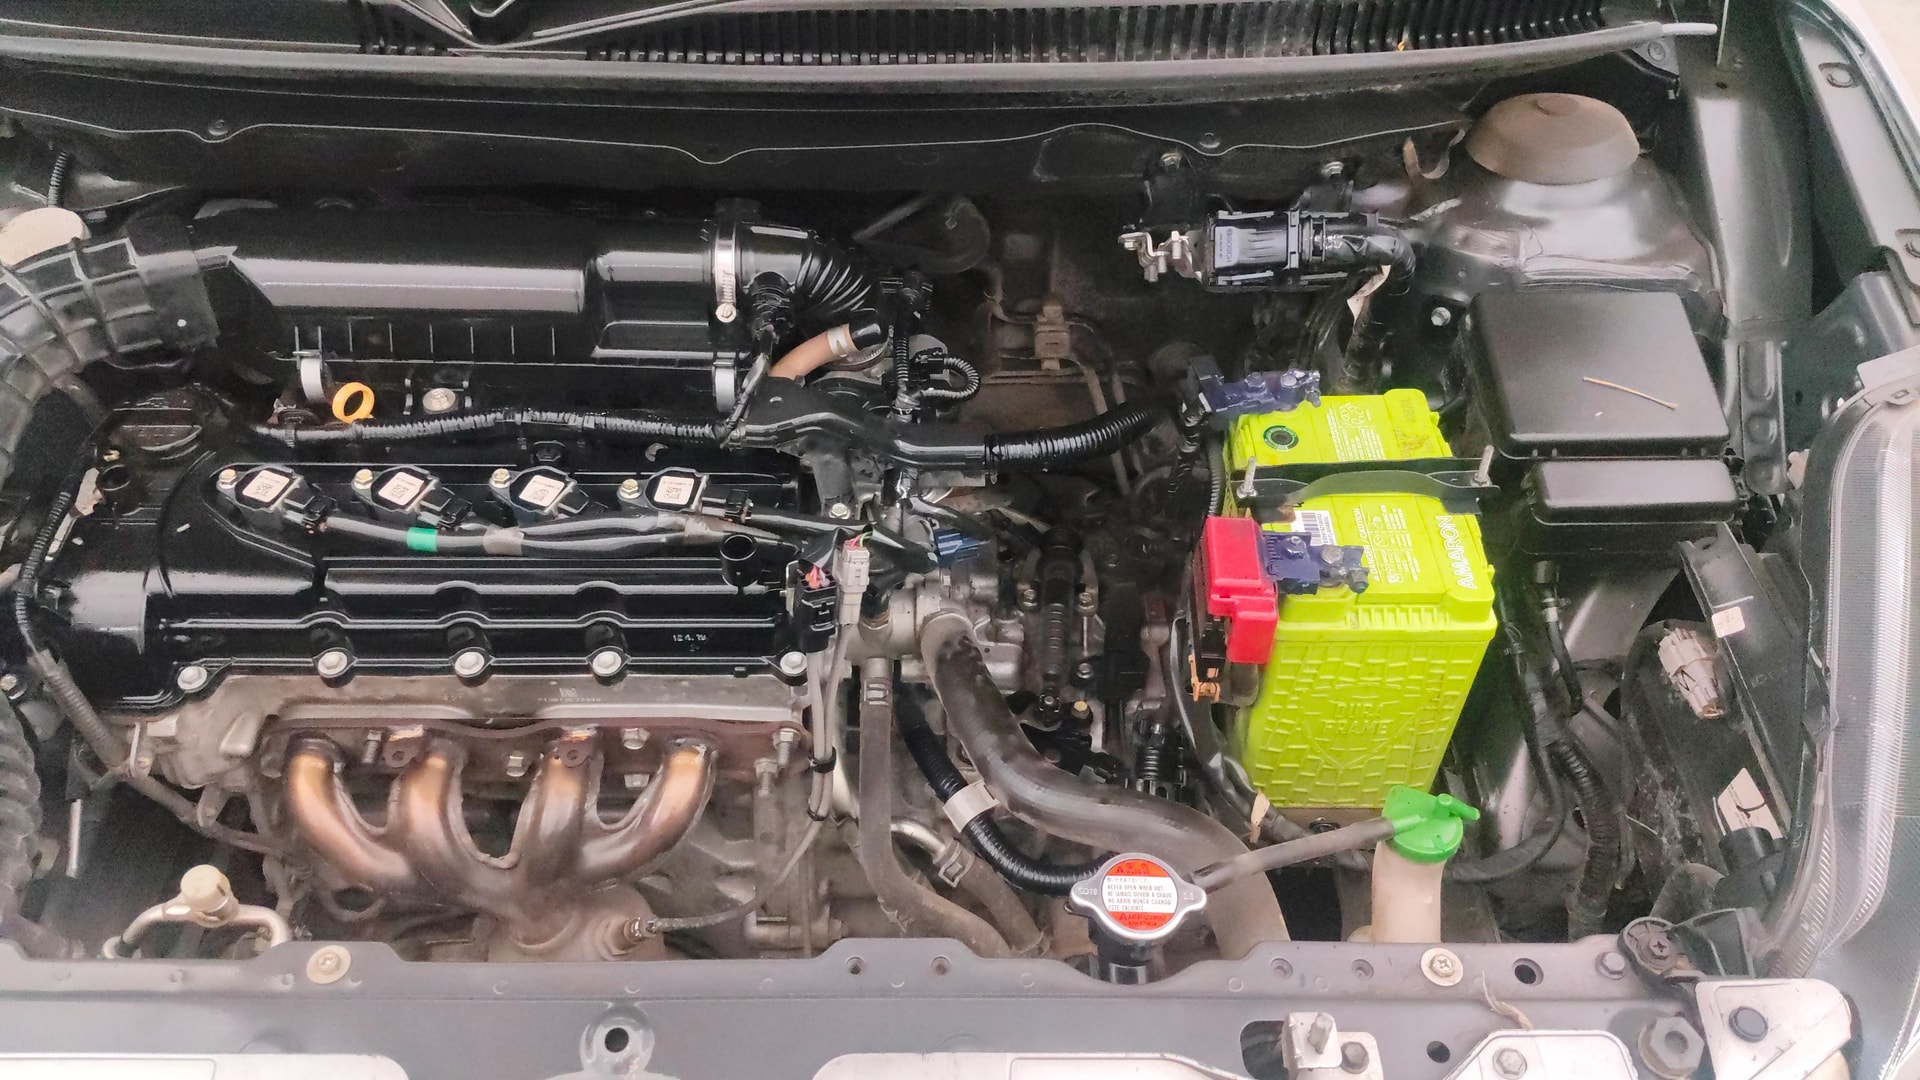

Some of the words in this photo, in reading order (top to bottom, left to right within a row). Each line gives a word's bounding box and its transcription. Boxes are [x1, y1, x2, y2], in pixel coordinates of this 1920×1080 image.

[1353, 508, 1367, 539] CAUTION
[1363, 545, 1378, 574] DANGER
[1435, 515, 1478, 590] AMARON
[1334, 703, 1384, 718] DURA
[1321, 720, 1390, 735] FRAME
